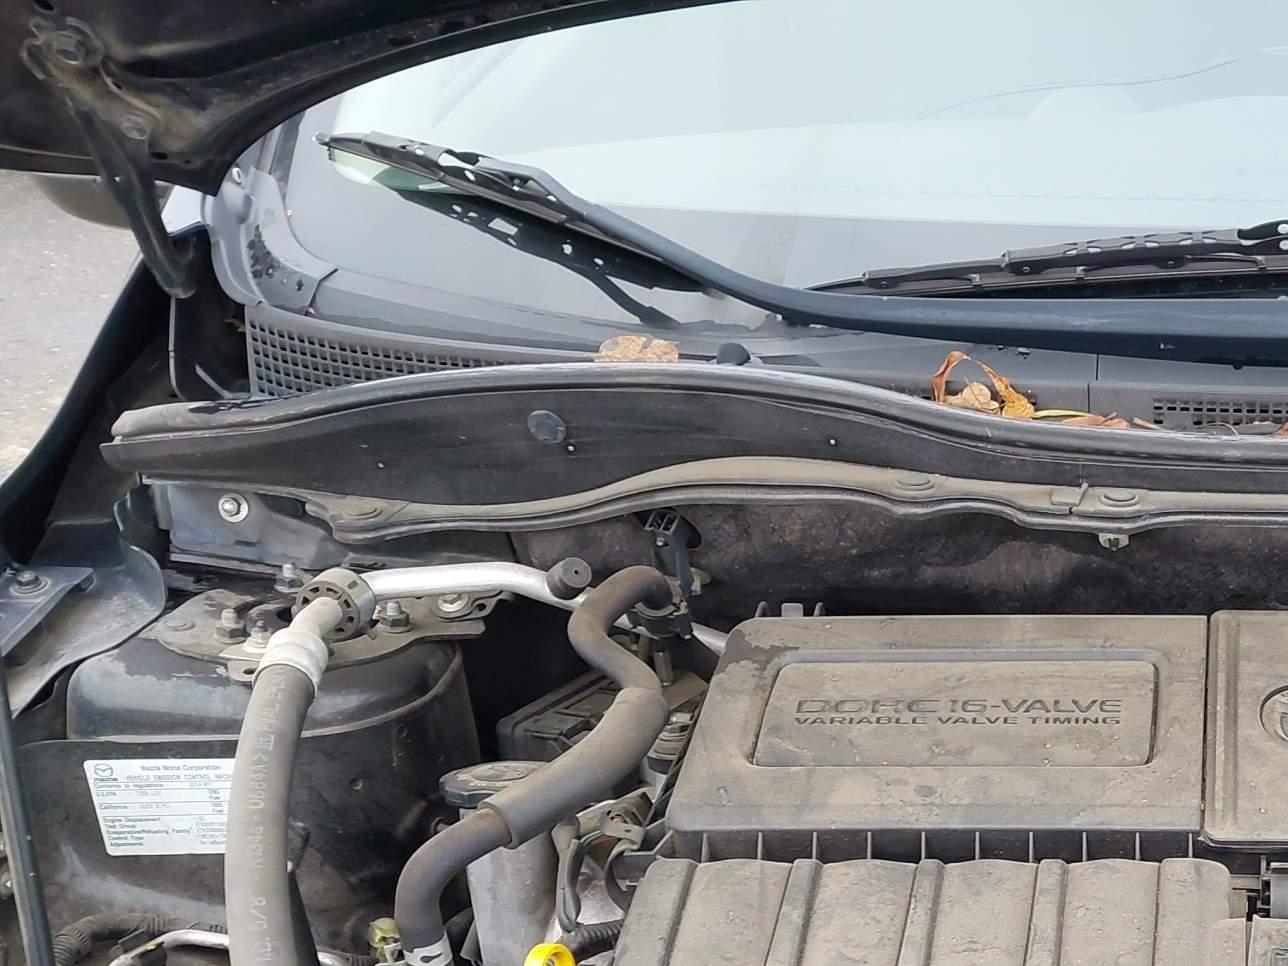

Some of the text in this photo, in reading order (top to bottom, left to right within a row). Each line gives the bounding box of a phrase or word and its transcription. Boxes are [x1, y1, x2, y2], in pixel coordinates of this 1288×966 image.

[795, 699, 1122, 713] DOHC 16-VALVE
[795, 716, 1122, 725] VARIABLE VALVE TIMING
